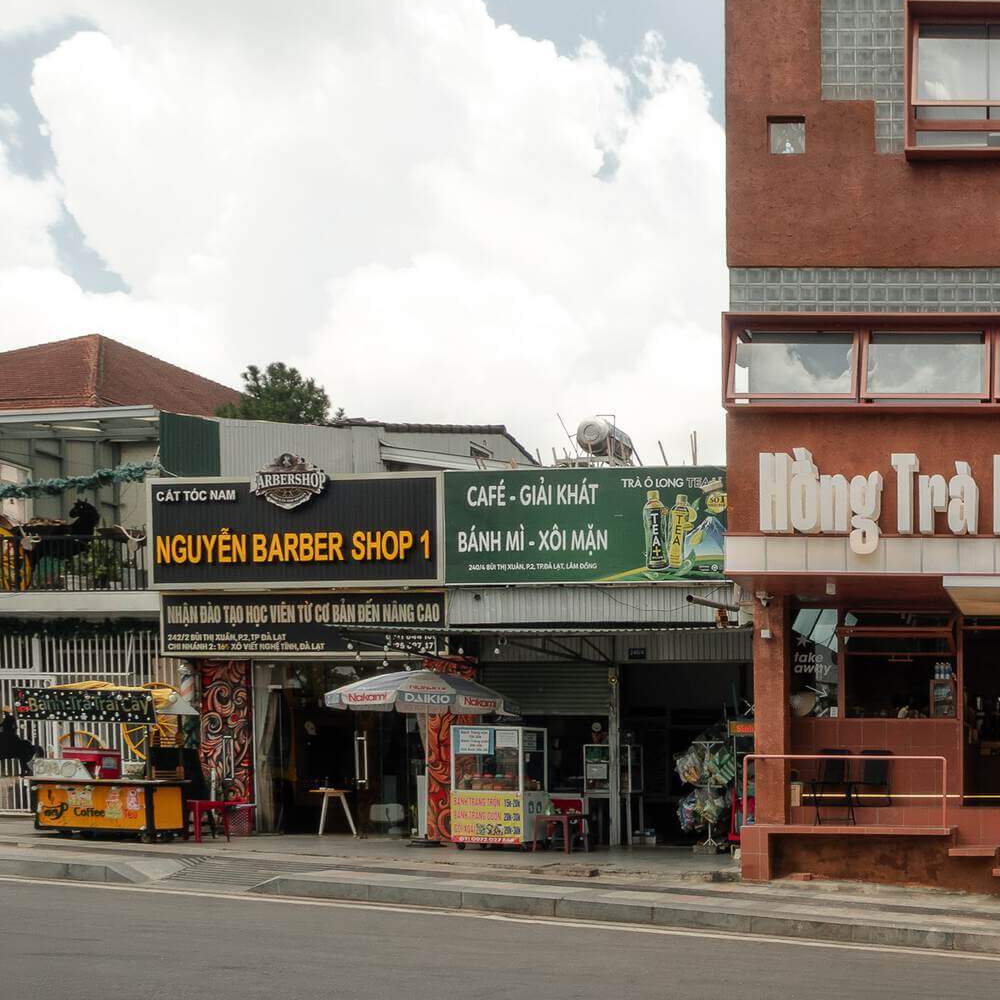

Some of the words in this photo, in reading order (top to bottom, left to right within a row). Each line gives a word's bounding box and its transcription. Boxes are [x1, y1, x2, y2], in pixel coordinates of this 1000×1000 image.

[621, 475, 642, 488] TRÀ
[644, 475, 653, 488] Ô
[655, 478, 684, 488] LONG
[183, 487, 207, 501] TÓC
[209, 489, 236, 500] NAM
[466, 478, 506, 507] CAFÉ
[519, 476, 552, 506] GIẢI
[557, 477, 599, 505] KHÁT
[891, 453, 979, 535] Trà
[156, 527, 246, 564] NGUYỄN
[252, 532, 345, 562] BARBER
[351, 530, 413, 561] SHOP
[420, 529, 431, 559] 1
[458, 524, 501, 553] BÁNH
[506, 523, 525, 552] MÌ
[538, 523, 567, 551] XÔI
[571, 523, 608, 556] MẶN
[167, 601, 199, 627] NHẬN
[200, 600, 222, 624] ĐÀO
[223, 604, 245, 627] TẠO
[246, 604, 268, 627] HỌC
[270, 600, 296, 624] VIÊN
[314, 602, 330, 623] CƠ
[358, 598, 380, 623] ĐẾN
[382, 600, 415, 622] NÂNG
[416, 603, 440, 622] CAO
[794, 651, 824, 663] take
[794, 663, 832, 676] away
[348, 692, 388, 702] Nakami
[404, 692, 450, 704] DAIKIO
[73, 807, 106, 818] Coffee
